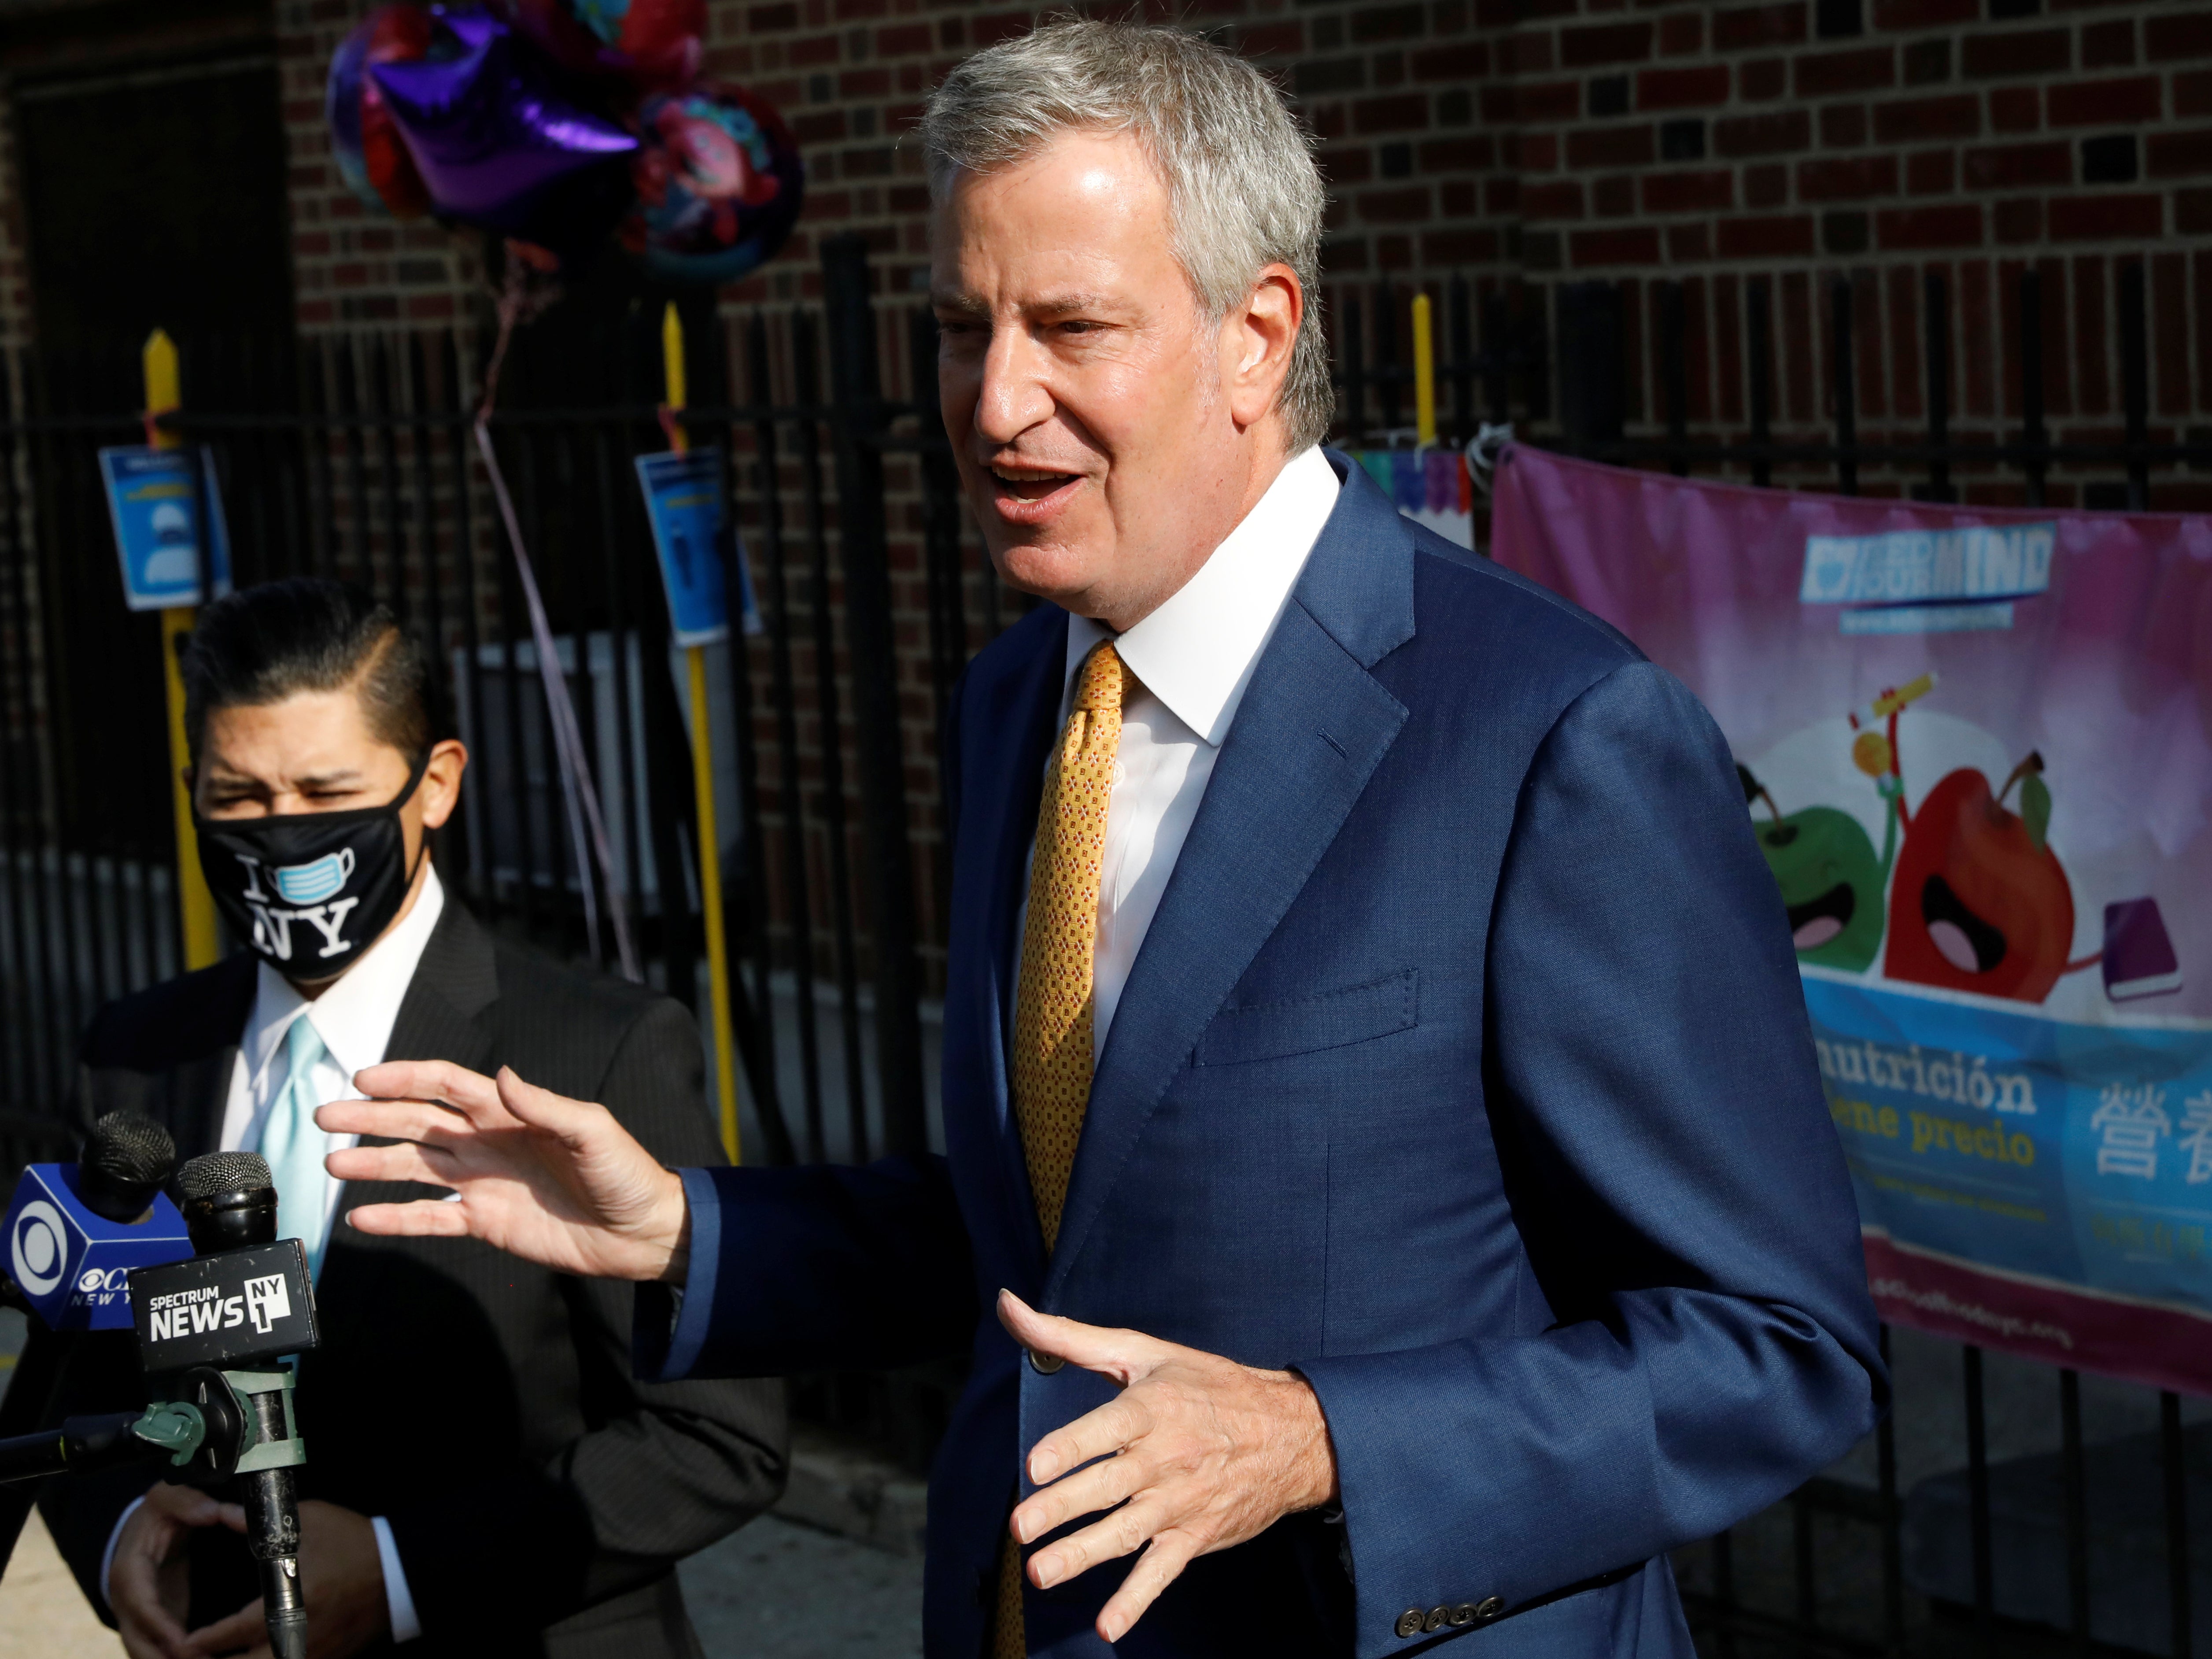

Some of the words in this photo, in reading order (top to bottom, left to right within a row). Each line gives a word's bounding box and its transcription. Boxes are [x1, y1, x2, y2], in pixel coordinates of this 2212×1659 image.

[235, 853, 269, 903] I
[245, 896, 360, 961] NY
[1828, 1093, 1900, 1138] ene
[1909, 1111, 2035, 1167] precio
[71, 1292, 115, 1307] NEW
[150, 1285, 219, 1311] SPECTRUM
[251, 1277, 279, 1299] NY
[150, 1295, 244, 1342] NEWS
[255, 1302, 268, 1330] 1
